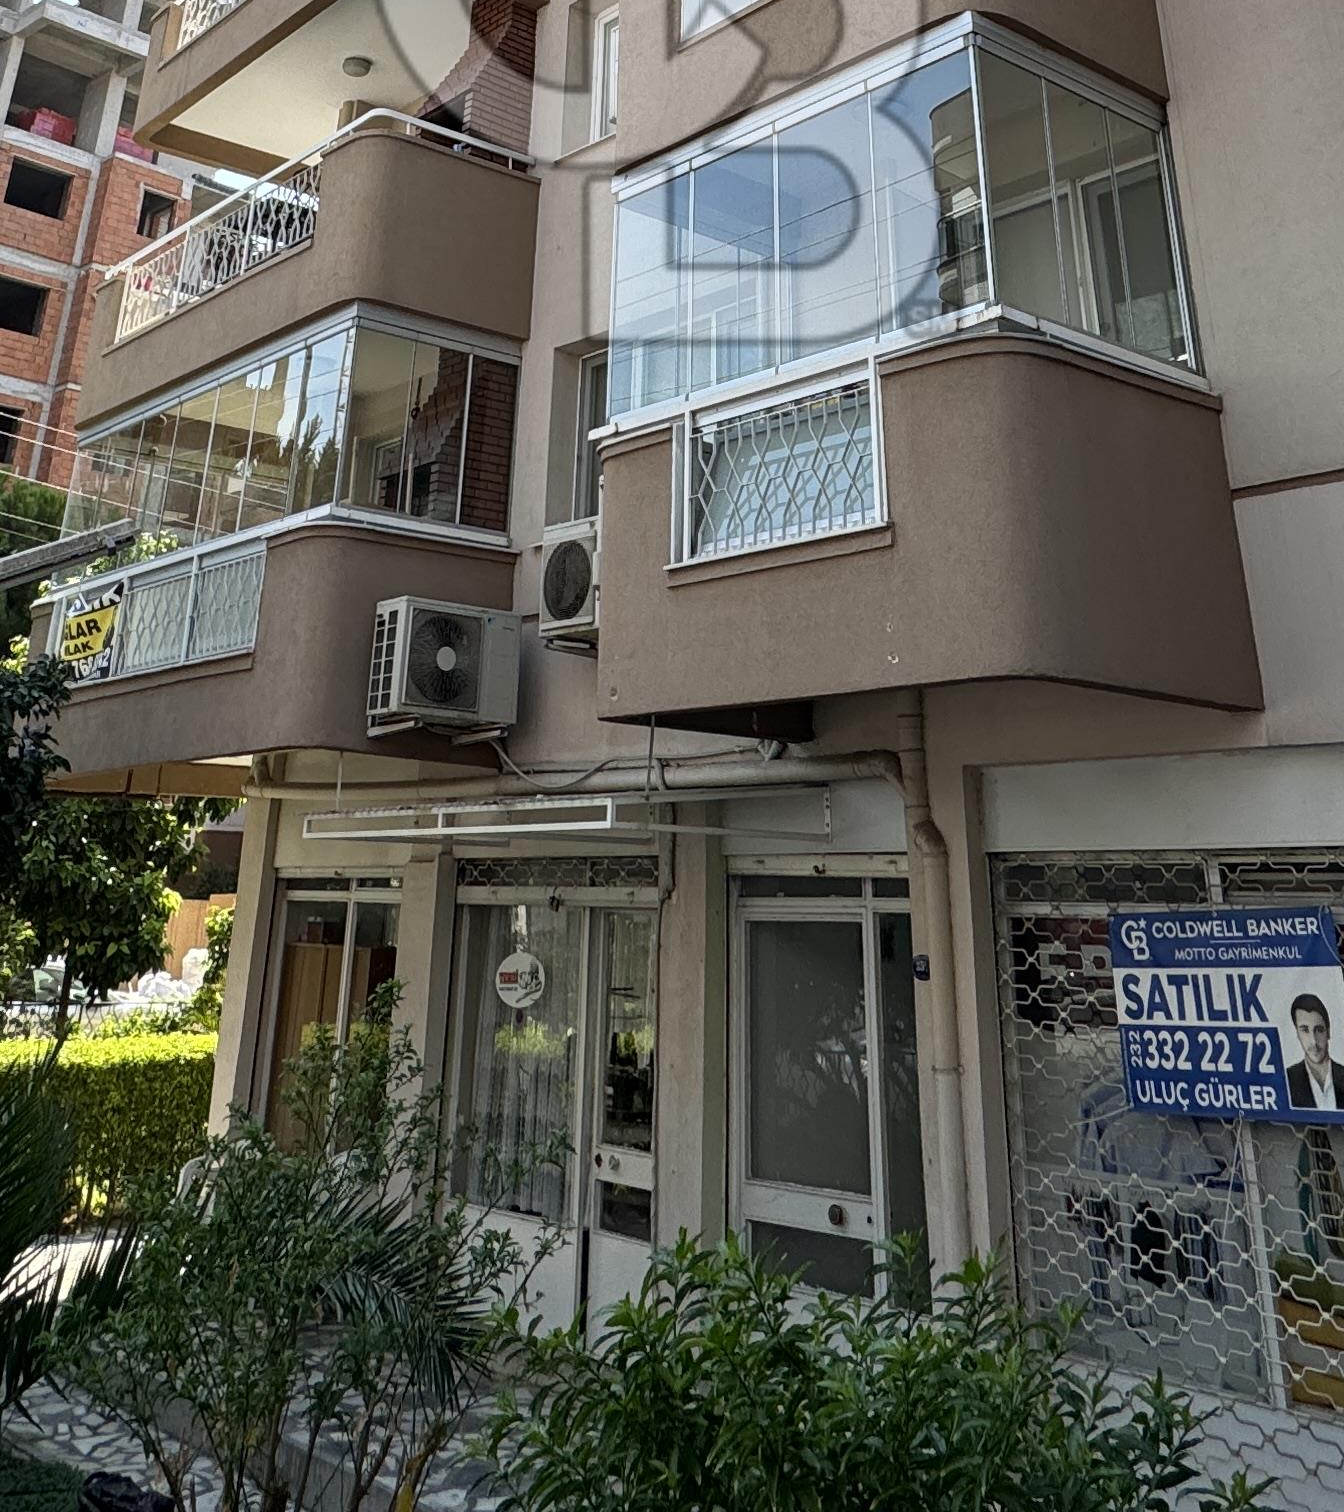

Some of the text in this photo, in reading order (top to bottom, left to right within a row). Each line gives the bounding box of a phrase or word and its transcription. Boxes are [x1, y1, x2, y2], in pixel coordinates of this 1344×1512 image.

[1152, 917, 1319, 938] COLDWELL BANKER
[1175, 944, 1303, 960] MOTTO GAYRİMENKUL
[1122, 973, 1270, 1023] SATILIK
[1129, 1030, 1143, 1068] 232
[1143, 1030, 1276, 1074] 332 22 72
[1136, 1077, 1279, 1112] ULUÇ GÜRLER
